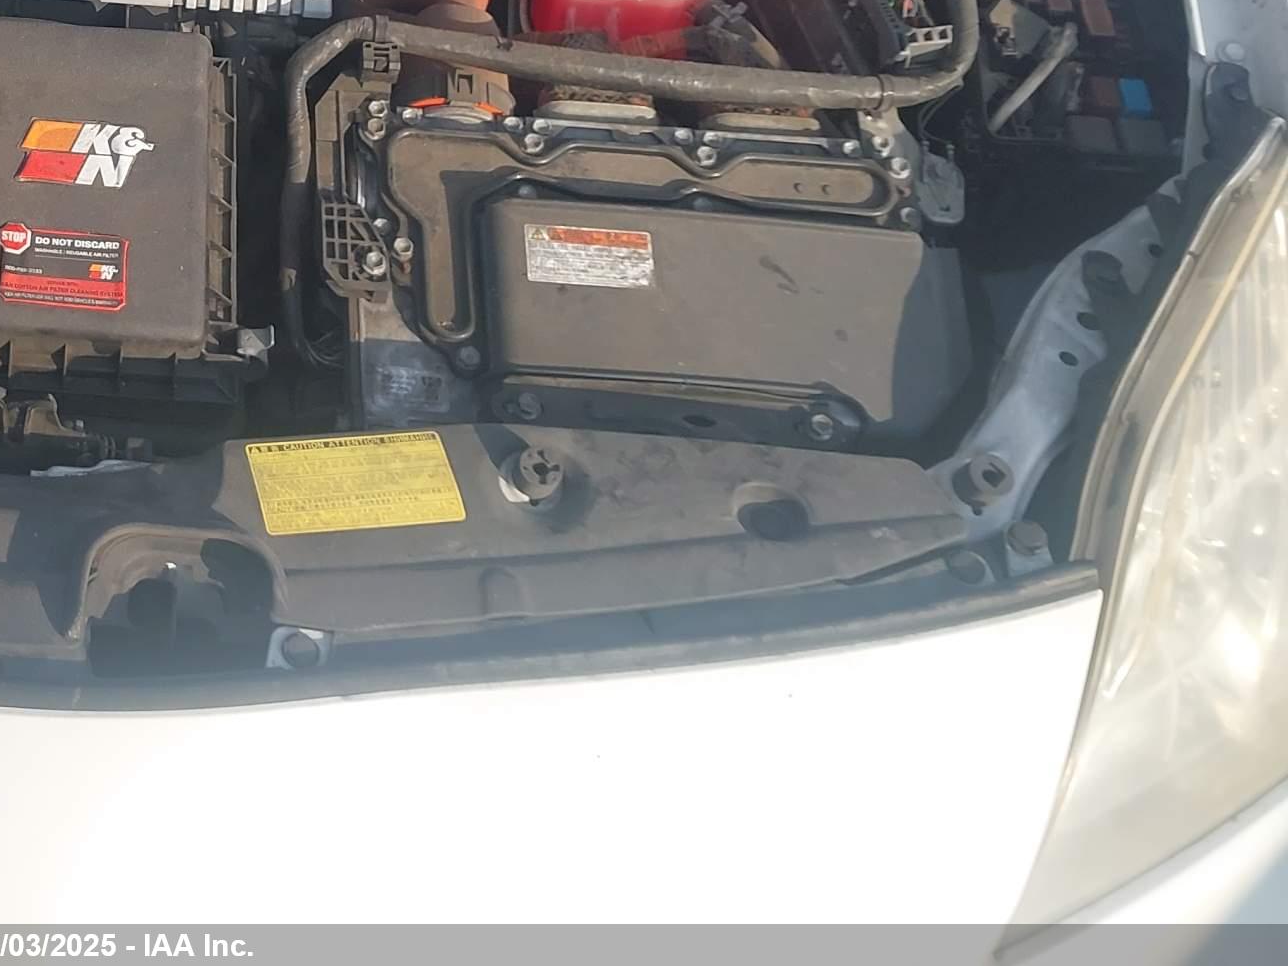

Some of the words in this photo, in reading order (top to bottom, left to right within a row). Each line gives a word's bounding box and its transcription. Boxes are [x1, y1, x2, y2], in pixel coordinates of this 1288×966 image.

[1, 230, 27, 243] STOP
[35, 236, 50, 245] DO
[51, 237, 73, 247] NOT
[74, 239, 120, 249] DISCARD
